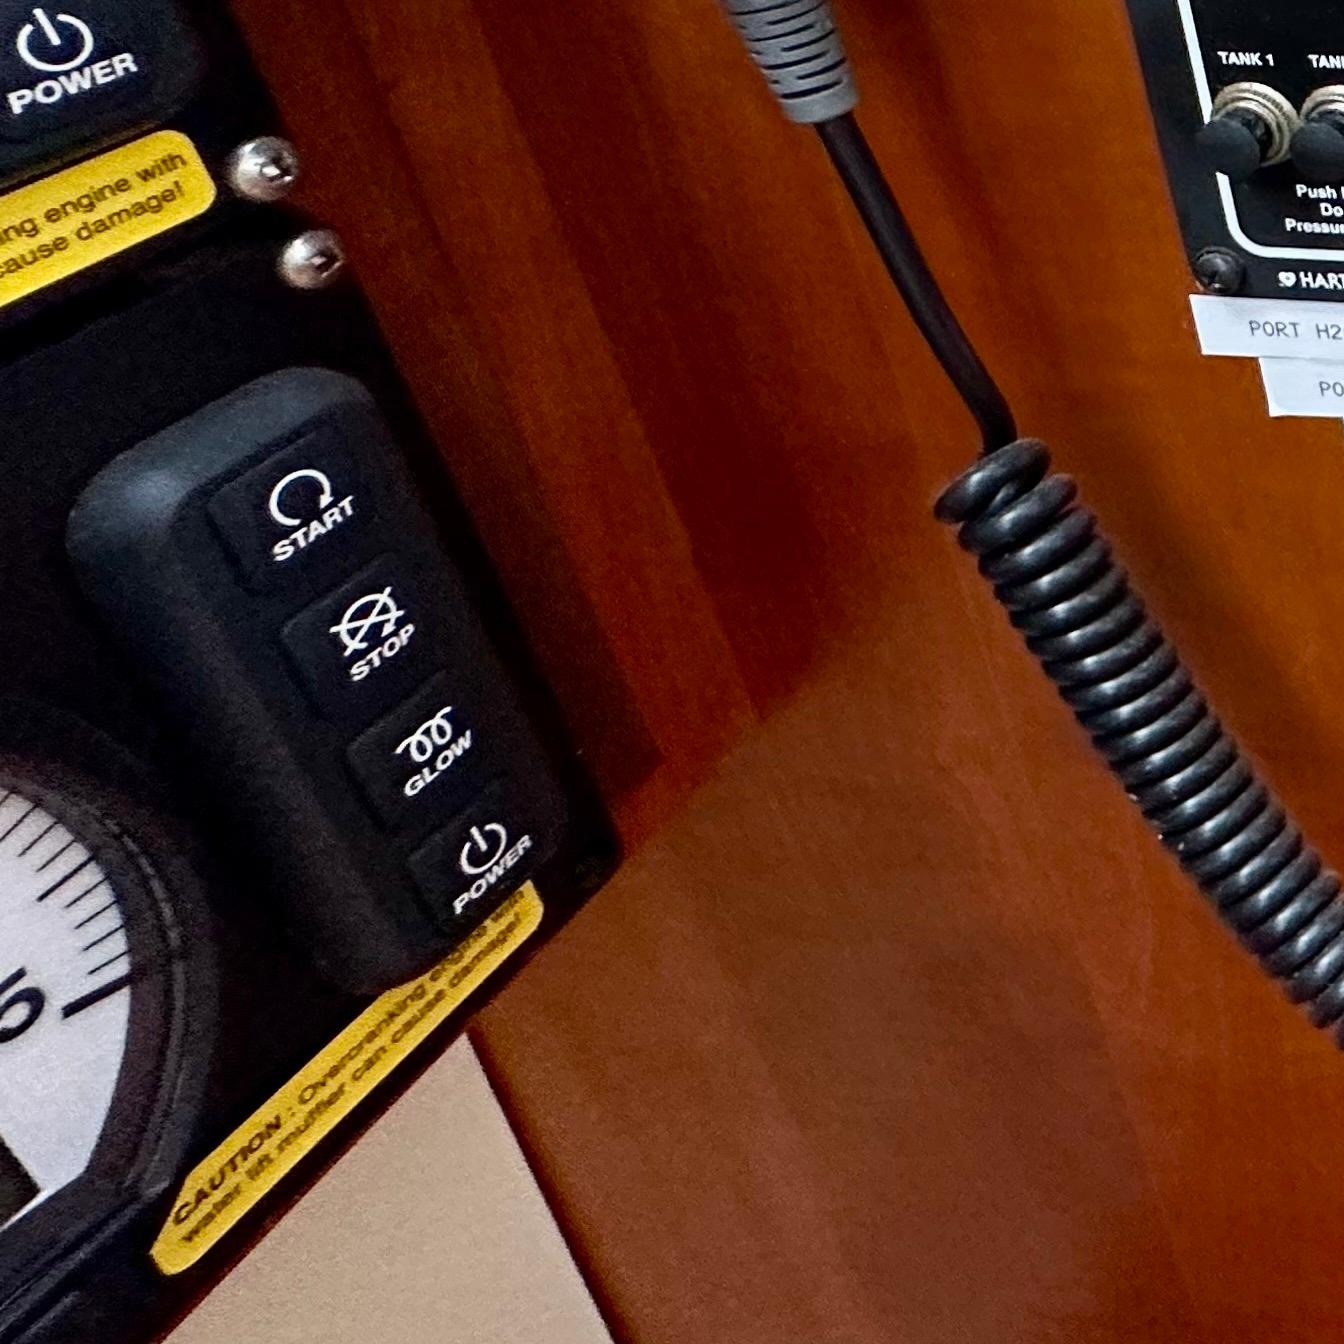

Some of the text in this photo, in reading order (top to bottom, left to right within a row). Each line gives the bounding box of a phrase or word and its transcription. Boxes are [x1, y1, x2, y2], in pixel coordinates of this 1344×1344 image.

[7, 51, 138, 114] POWER
[1217, 51, 1274, 66] TANK 1
[44, 154, 187, 223] engine with
[75, 179, 185, 241] damage!
[1296, 184, 1337, 199] Push
[1320, 203, 1343, 217] Do
[1249, 320, 1298, 337] PORT
[273, 495, 353, 561] START
[350, 623, 415, 681] STOP
[404, 729, 471, 796] GLOW
[453, 834, 533, 915] POWER
[173, 1114, 282, 1226] CAUTION
